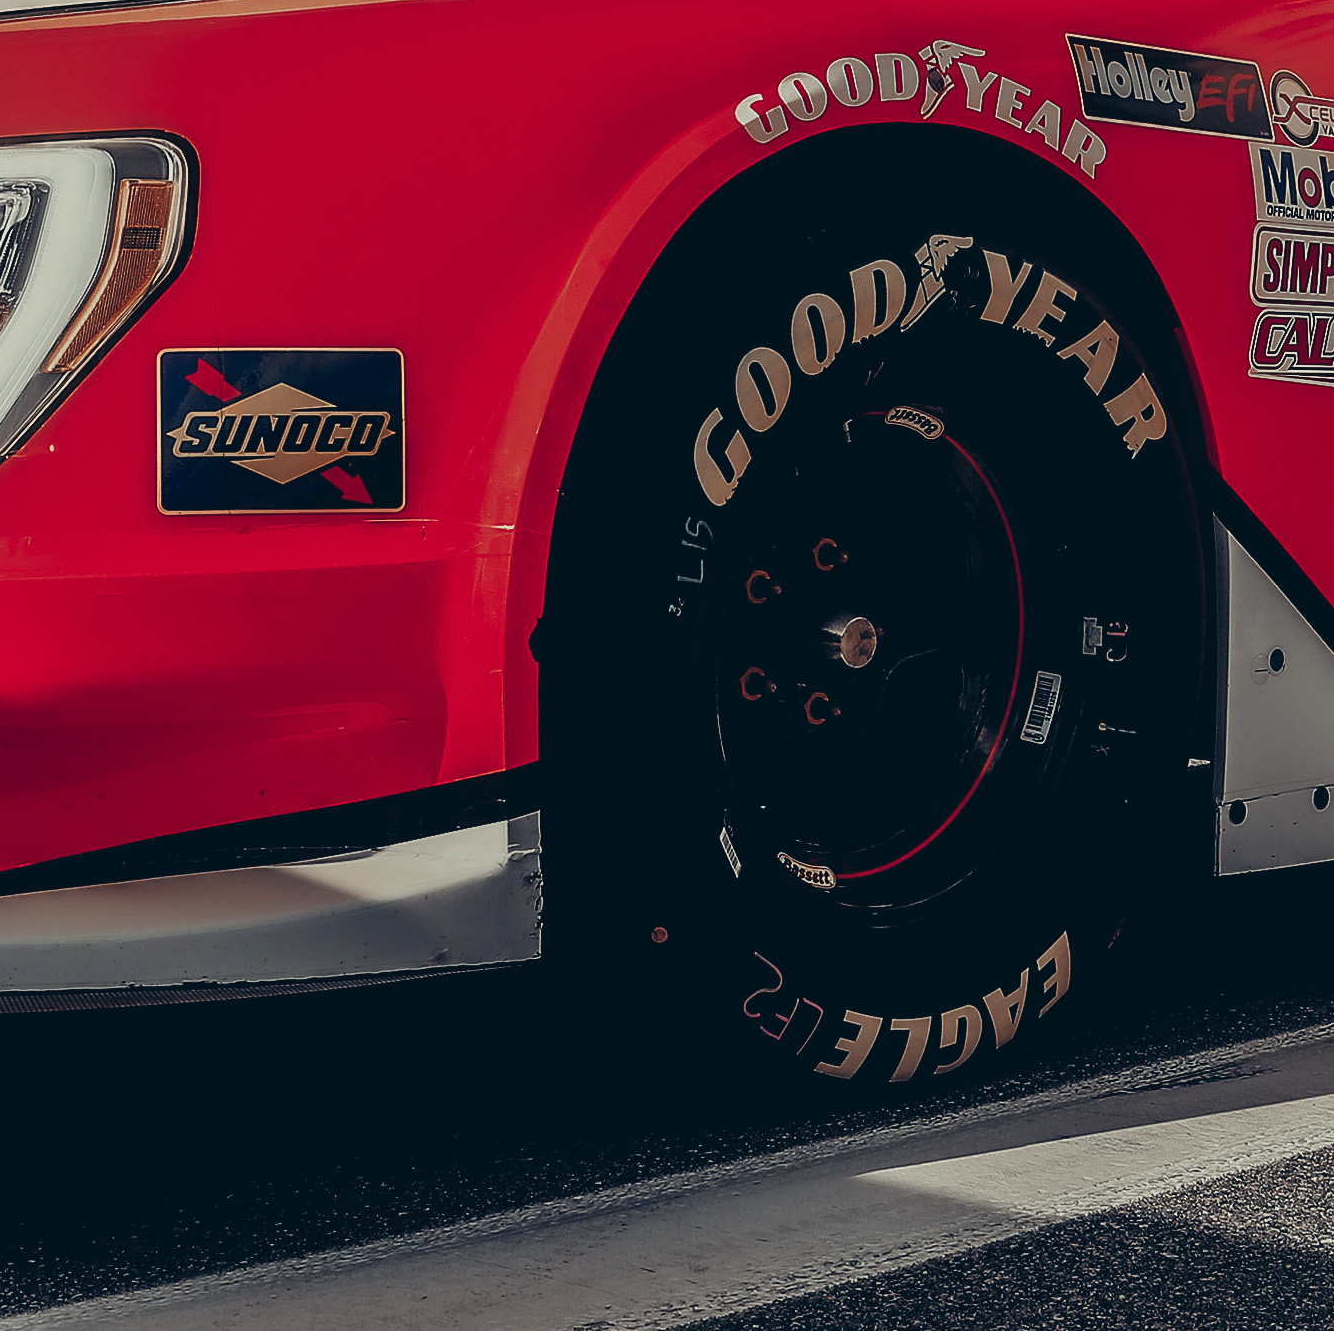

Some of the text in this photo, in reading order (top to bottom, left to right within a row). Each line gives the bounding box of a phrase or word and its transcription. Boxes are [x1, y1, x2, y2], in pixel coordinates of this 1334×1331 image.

[734, 52, 1107, 180] GOODYEAR
[1073, 43, 1195, 123] Holley
[1267, 204, 1304, 220] OFFICIAL
[693, 249, 1168, 507] GOODYEAR
[180, 415, 386, 454] SUNOCO
[814, 930, 1072, 1083] EAGLE
